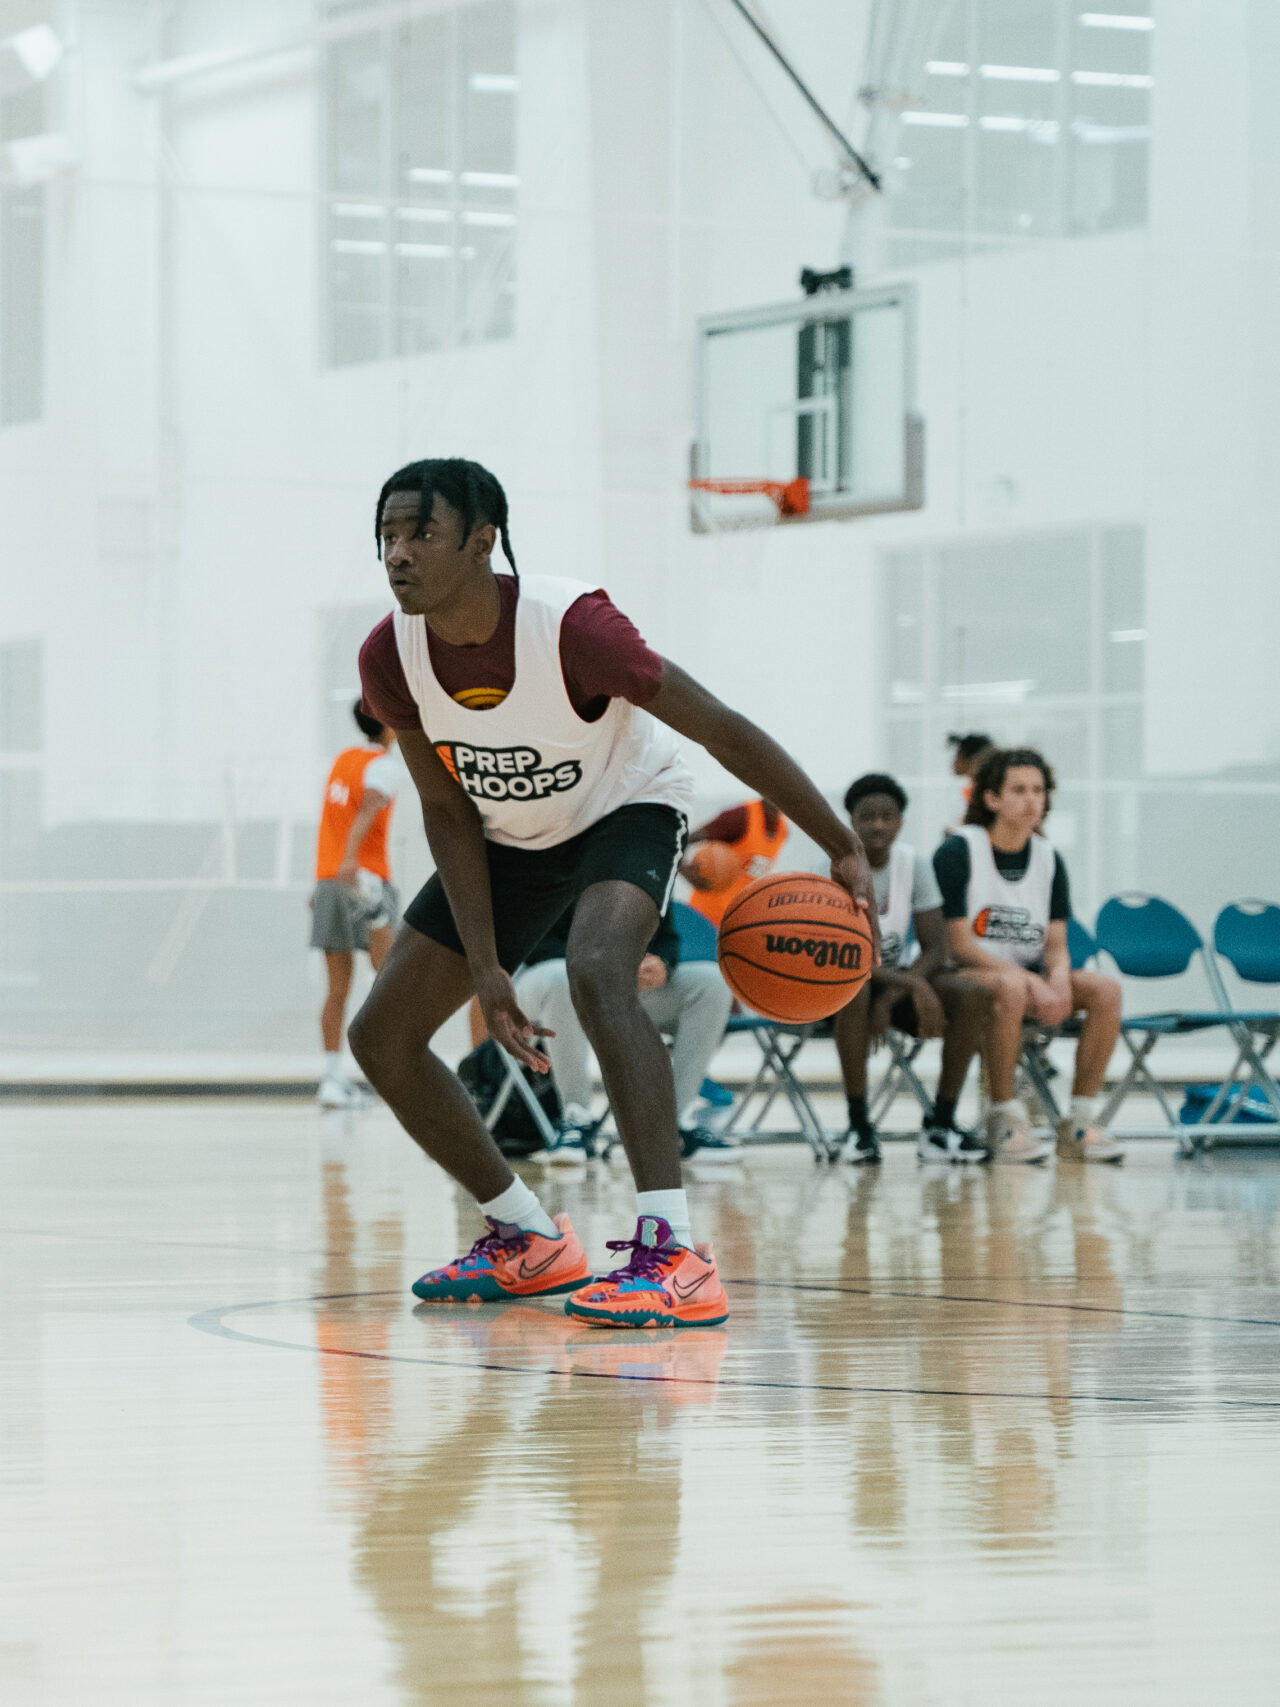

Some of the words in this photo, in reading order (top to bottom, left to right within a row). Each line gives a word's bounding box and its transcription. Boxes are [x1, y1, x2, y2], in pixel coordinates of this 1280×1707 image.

[455, 746, 536, 774] PREP
[459, 764, 577, 798] HOOPS
[765, 934, 862, 970] Wilson
